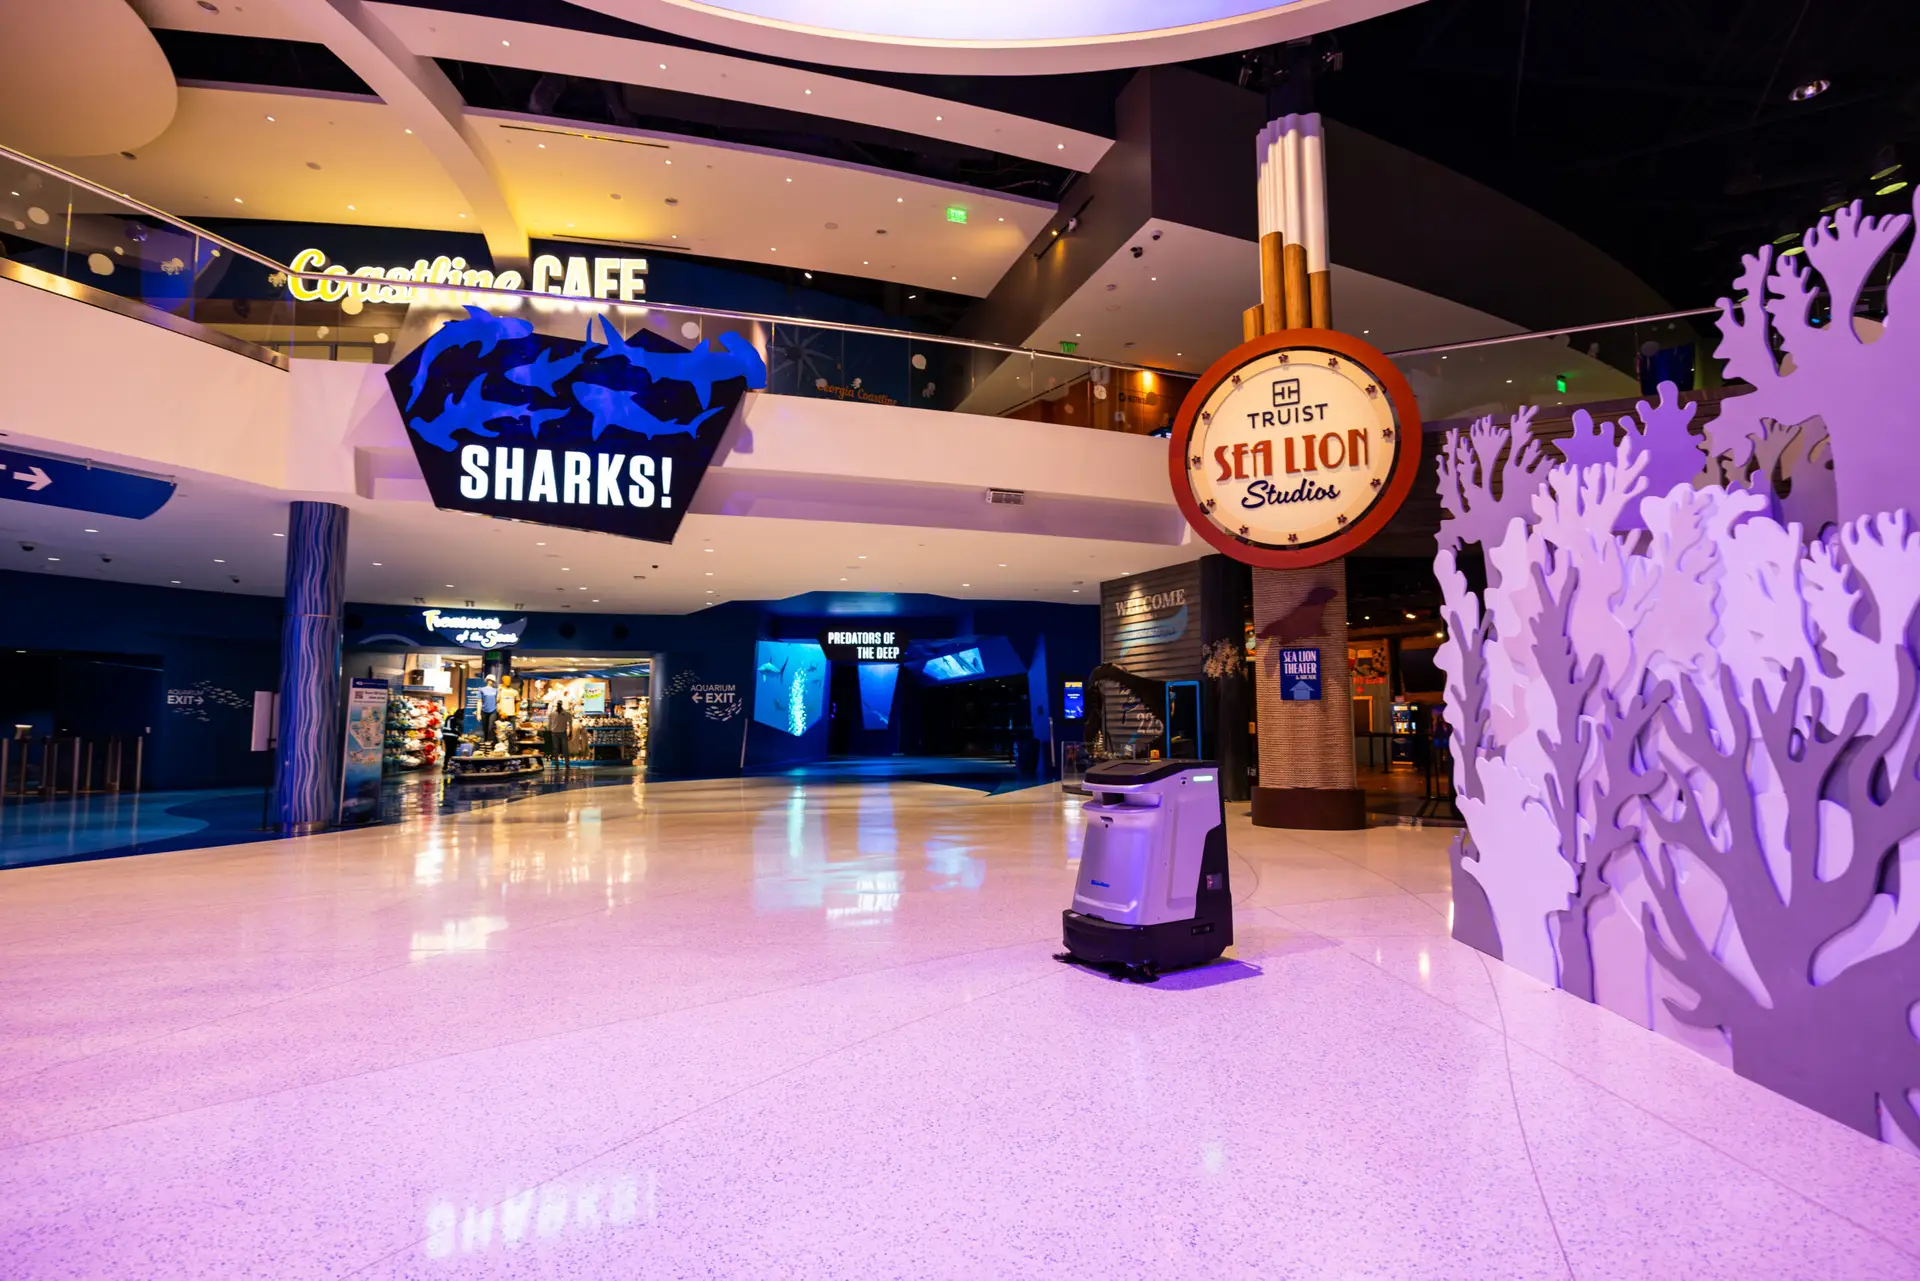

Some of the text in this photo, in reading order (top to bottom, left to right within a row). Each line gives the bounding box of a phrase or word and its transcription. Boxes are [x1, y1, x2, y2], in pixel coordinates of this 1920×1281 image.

[287, 248, 648, 306] Coastline CAFE
[1247, 403, 1329, 429] TRUIST
[1214, 428, 1369, 483] SEA LION
[460, 444, 673, 509] SHARKS!
[1242, 478, 1341, 509] Studios
[828, 632, 895, 644] PREDATORS OF
[857, 647, 900, 659] THE DEEP
[1283, 650, 1317, 663] SEA LION
[1284, 663, 1317, 675] THEATER
[690, 684, 736, 692] AQUARIUM
[168, 695, 195, 705] EXIT
[706, 693, 736, 704] EXIT
